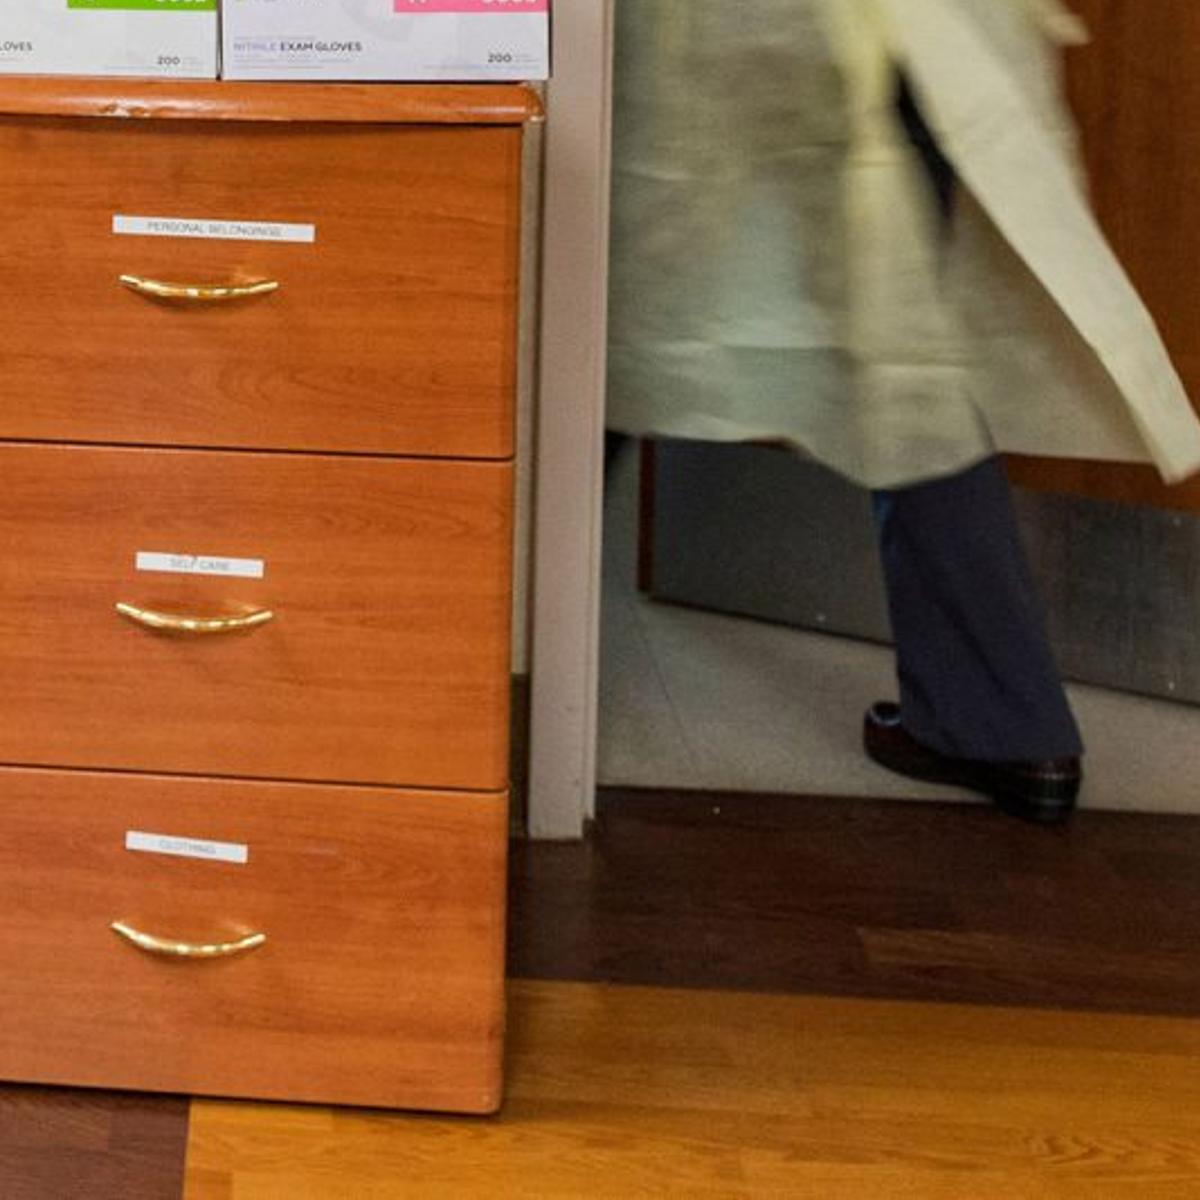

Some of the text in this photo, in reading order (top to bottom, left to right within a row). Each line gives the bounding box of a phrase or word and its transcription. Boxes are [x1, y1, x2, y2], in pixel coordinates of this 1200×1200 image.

[280, 41, 313, 51] EXAM
[315, 41, 362, 51] GLOVES
[157, 56, 180, 65] 200
[487, 54, 512, 63] 200
[147, 221, 205, 234] PERSONAL
